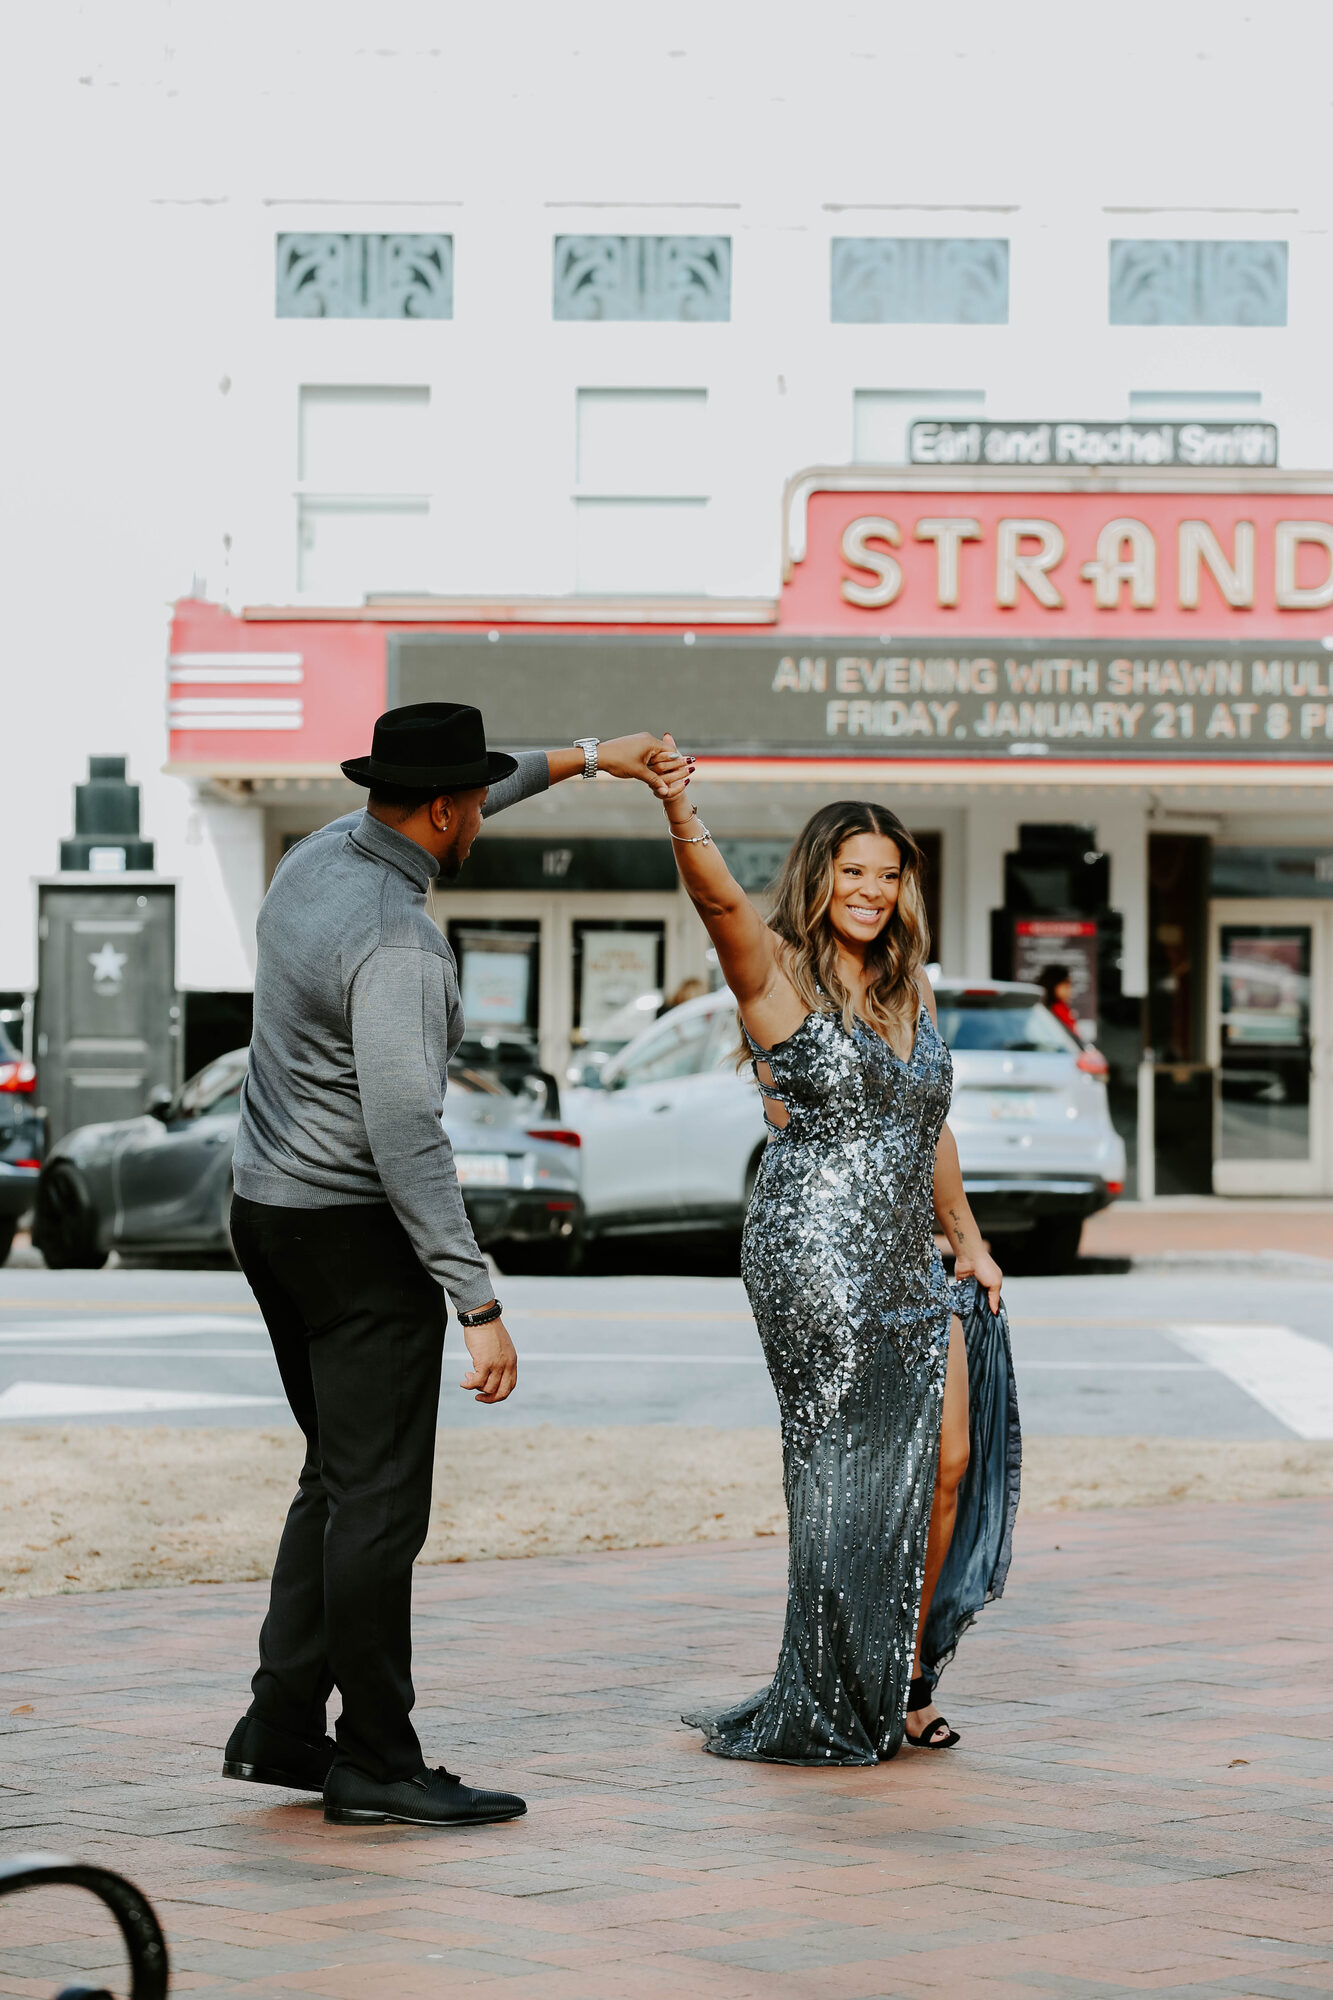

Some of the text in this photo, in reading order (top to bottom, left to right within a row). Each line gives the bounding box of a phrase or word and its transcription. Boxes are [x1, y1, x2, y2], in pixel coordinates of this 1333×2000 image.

[913, 424, 1275, 466] Earl and Rachel Smith
[841, 515, 1333, 609] STRAND
[772, 656, 1333, 697] AN EVENING WITH SHAWN MUL
[973, 701, 1145, 738] JANUARY
[1152, 702, 1195, 738] 21
[1205, 702, 1260, 739] AT
[1264, 702, 1291, 739] 8
[1301, 702, 1333, 739] P
